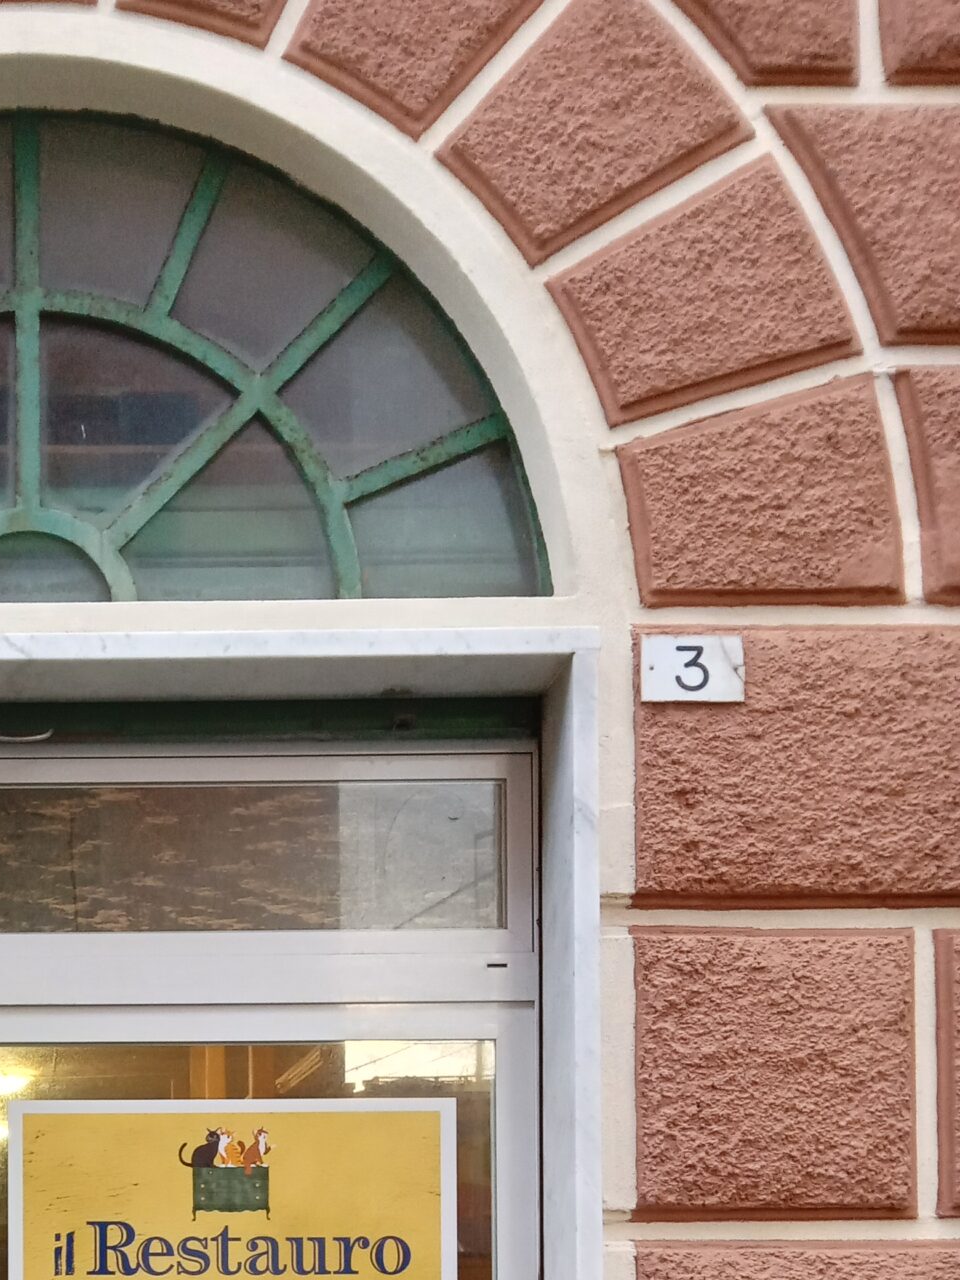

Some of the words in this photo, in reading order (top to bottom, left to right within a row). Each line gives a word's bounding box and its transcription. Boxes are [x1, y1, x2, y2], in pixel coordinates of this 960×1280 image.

[675, 645, 709, 692] 3
[54, 1230, 76, 1276] il
[86, 1220, 412, 1276] Restauro
